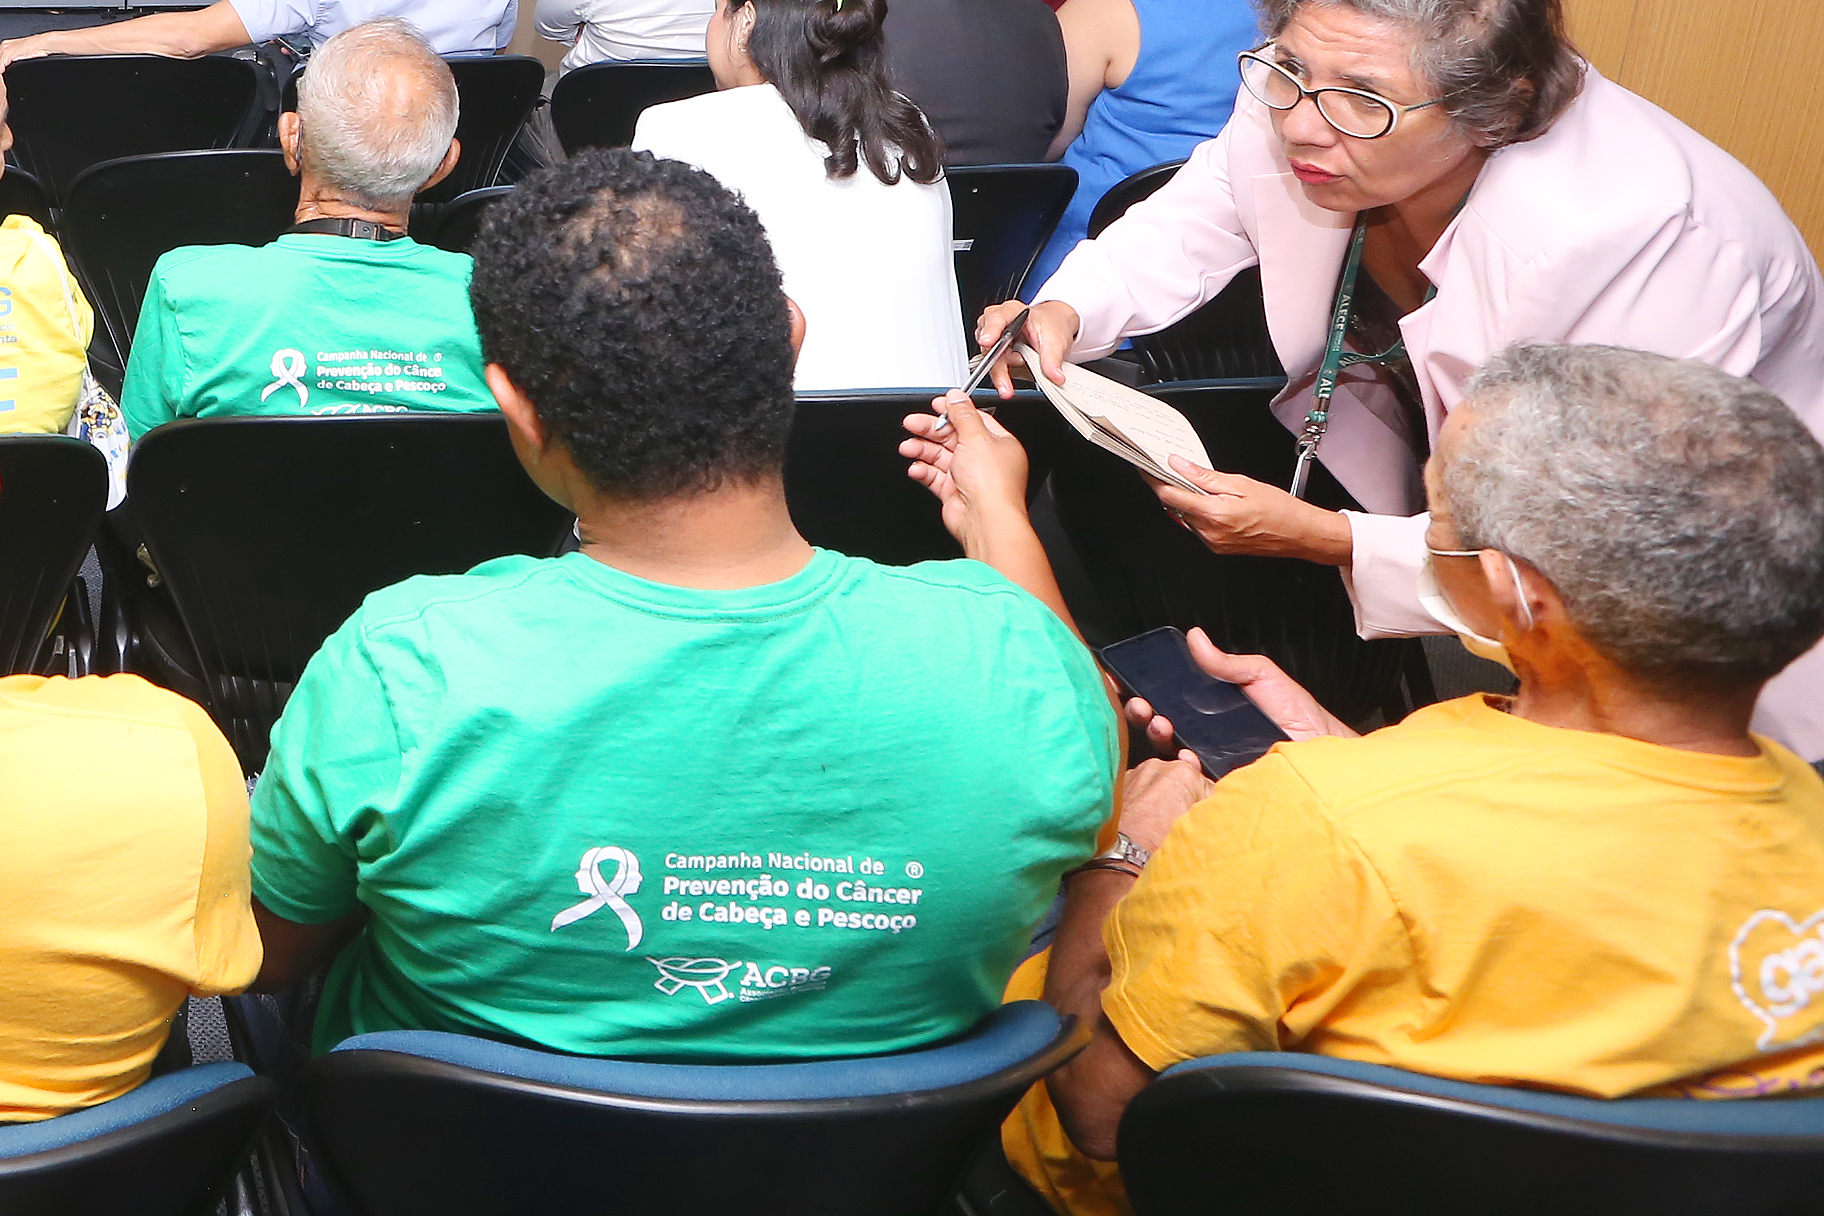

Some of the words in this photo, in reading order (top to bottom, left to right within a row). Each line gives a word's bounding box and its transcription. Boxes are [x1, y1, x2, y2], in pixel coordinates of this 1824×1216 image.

[316, 349, 368, 363] Campanha
[370, 350, 413, 362] Nacional
[415, 352, 428, 362] de
[316, 362, 383, 379] Prevenção
[384, 363, 402, 376] do
[316, 379, 334, 389] de
[335, 379, 383, 395] Cabeça
[384, 382, 394, 392] e
[394, 379, 447, 394] Pescoço
[664, 852, 763, 873] Campanha
[767, 852, 854, 875] Nacional
[859, 857, 885, 876] de
[663, 873, 790, 902] Prevenção
[795, 877, 831, 901] do
[835, 879, 924, 905] Câncer
[661, 901, 693, 922] de
[698, 901, 788, 930] Cabeça
[793, 908, 812, 927] e
[817, 906, 918, 934] Pescoço
[740, 962, 832, 988] ACBG
[1760, 922, 1824, 1017] ga
